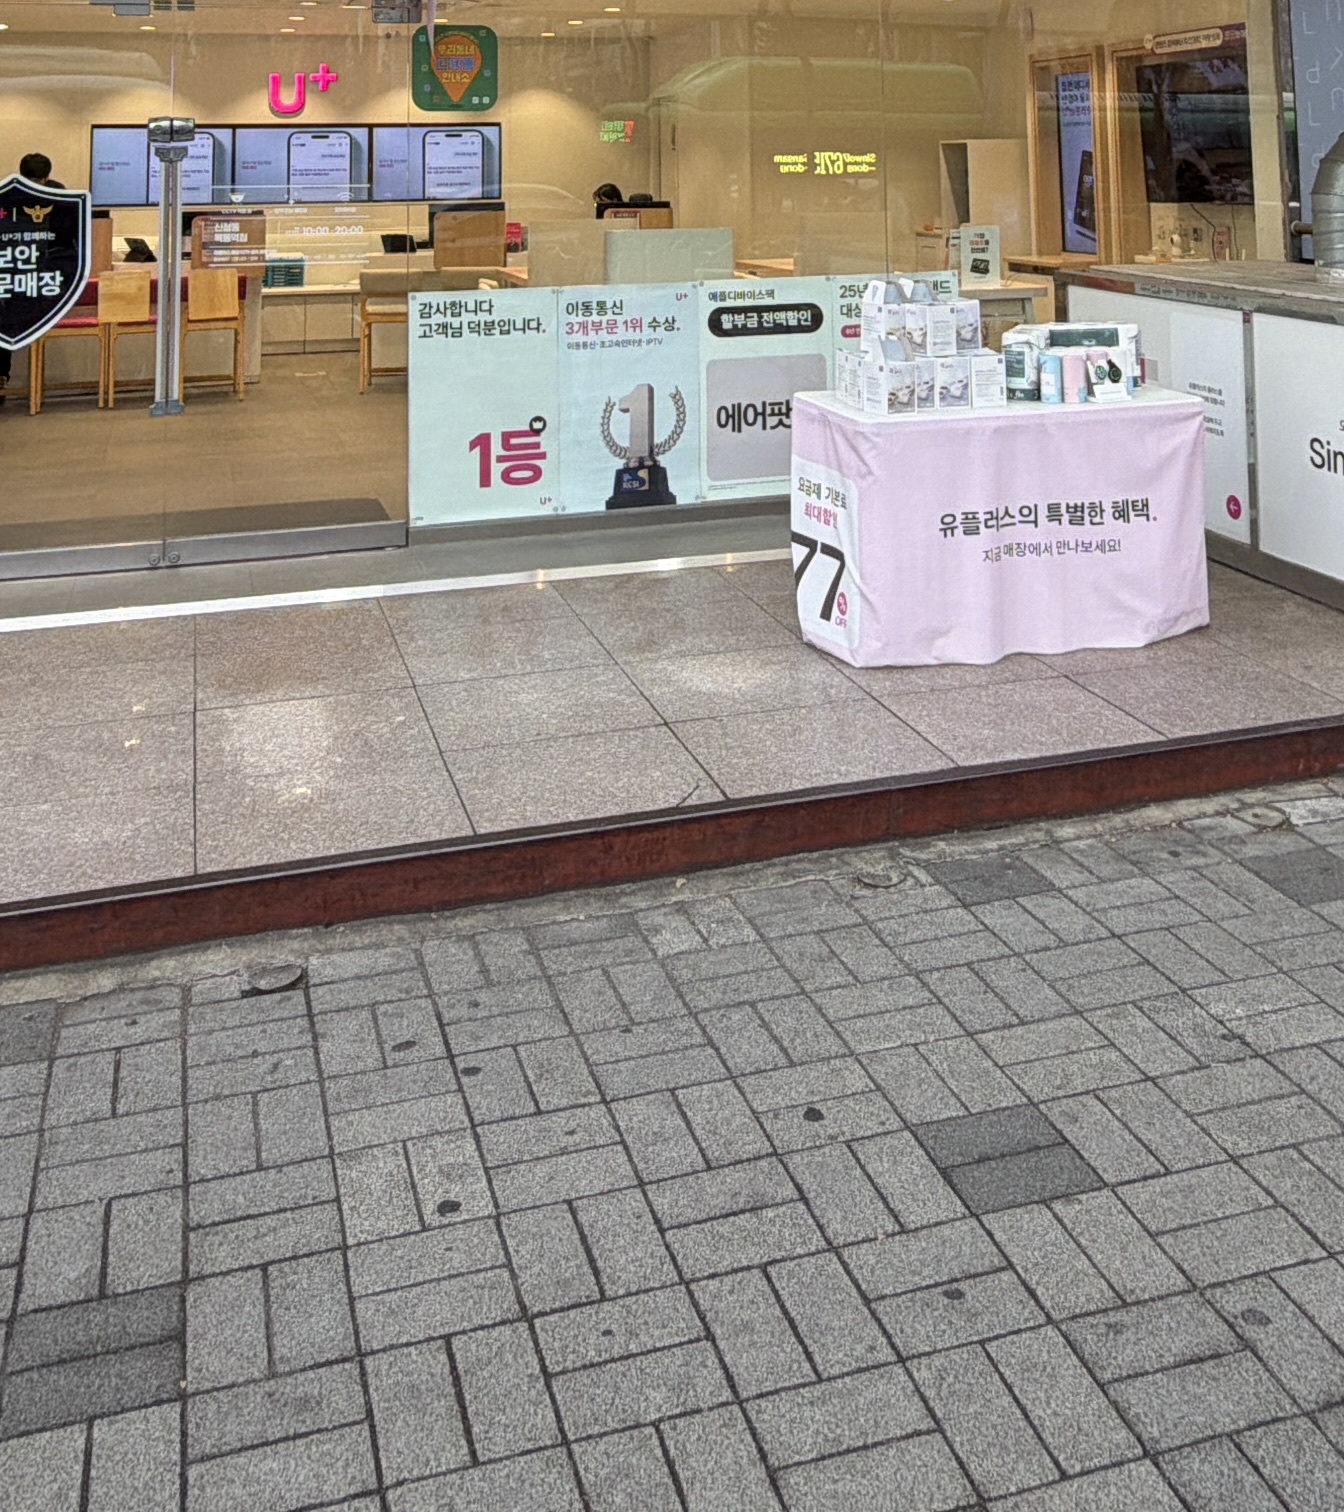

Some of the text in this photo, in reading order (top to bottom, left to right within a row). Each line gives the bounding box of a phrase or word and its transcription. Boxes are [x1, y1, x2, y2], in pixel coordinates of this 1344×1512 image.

[269, 63, 338, 115] U+
[565, 299, 624, 317] 이동통신
[675, 292, 689, 302] U+
[417, 299, 495, 319] 감사합니다
[720, 310, 812, 330] 할부금 전액할인
[418, 317, 547, 340] 고객님 덕분입니다.
[564, 315, 681, 337] 3개부문 1위 수상.
[467, 429, 548, 489] 1등
[798, 477, 821, 501] 요금제
[539, 495, 553, 506] U+
[939, 504, 1039, 539] 유플러스의
[1045, 500, 1106, 528] 특별한
[1055, 538, 1122, 555] 만나보세요!
[791, 530, 846, 622] 77
